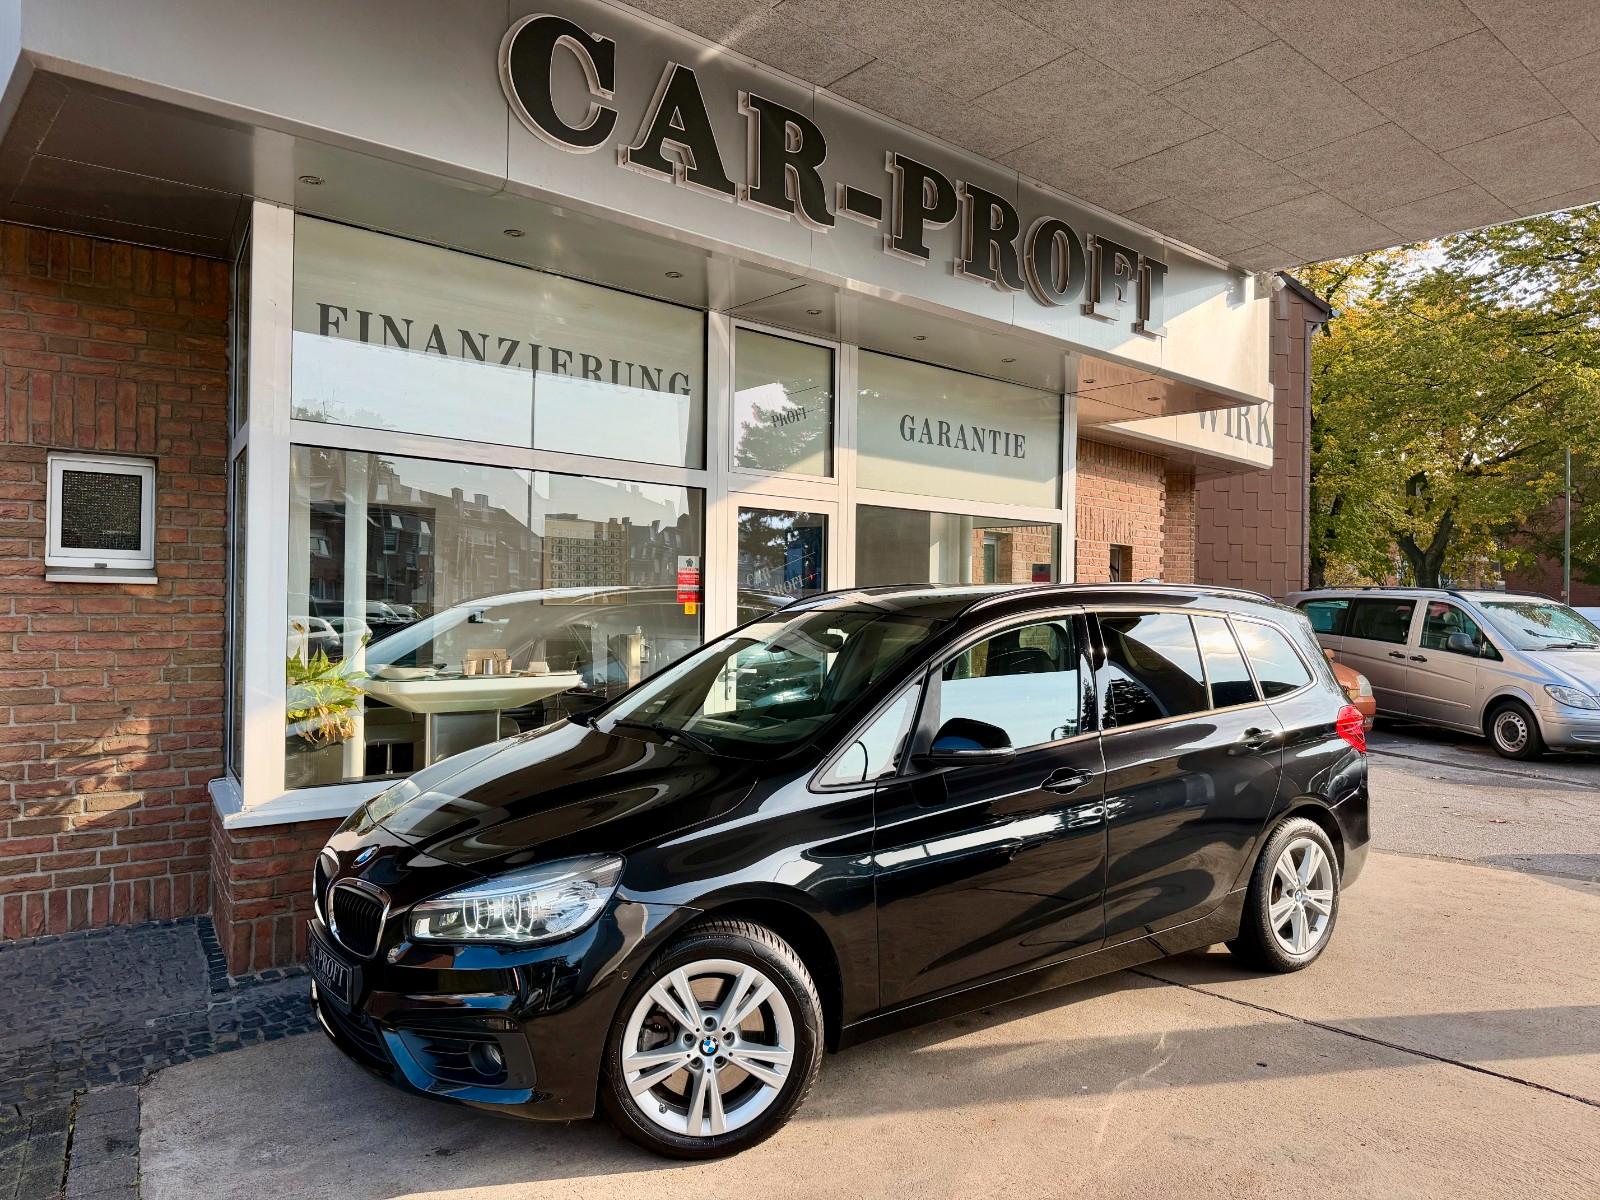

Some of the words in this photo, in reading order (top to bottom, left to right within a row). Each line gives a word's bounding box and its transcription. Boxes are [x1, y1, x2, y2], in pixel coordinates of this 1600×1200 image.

[499, 13, 1168, 337] CAR-PROFI
[315, 302, 692, 397] FINANZIERUNG
[771, 407, 807, 428] PROFI
[899, 414, 1026, 459] GARANTIE
